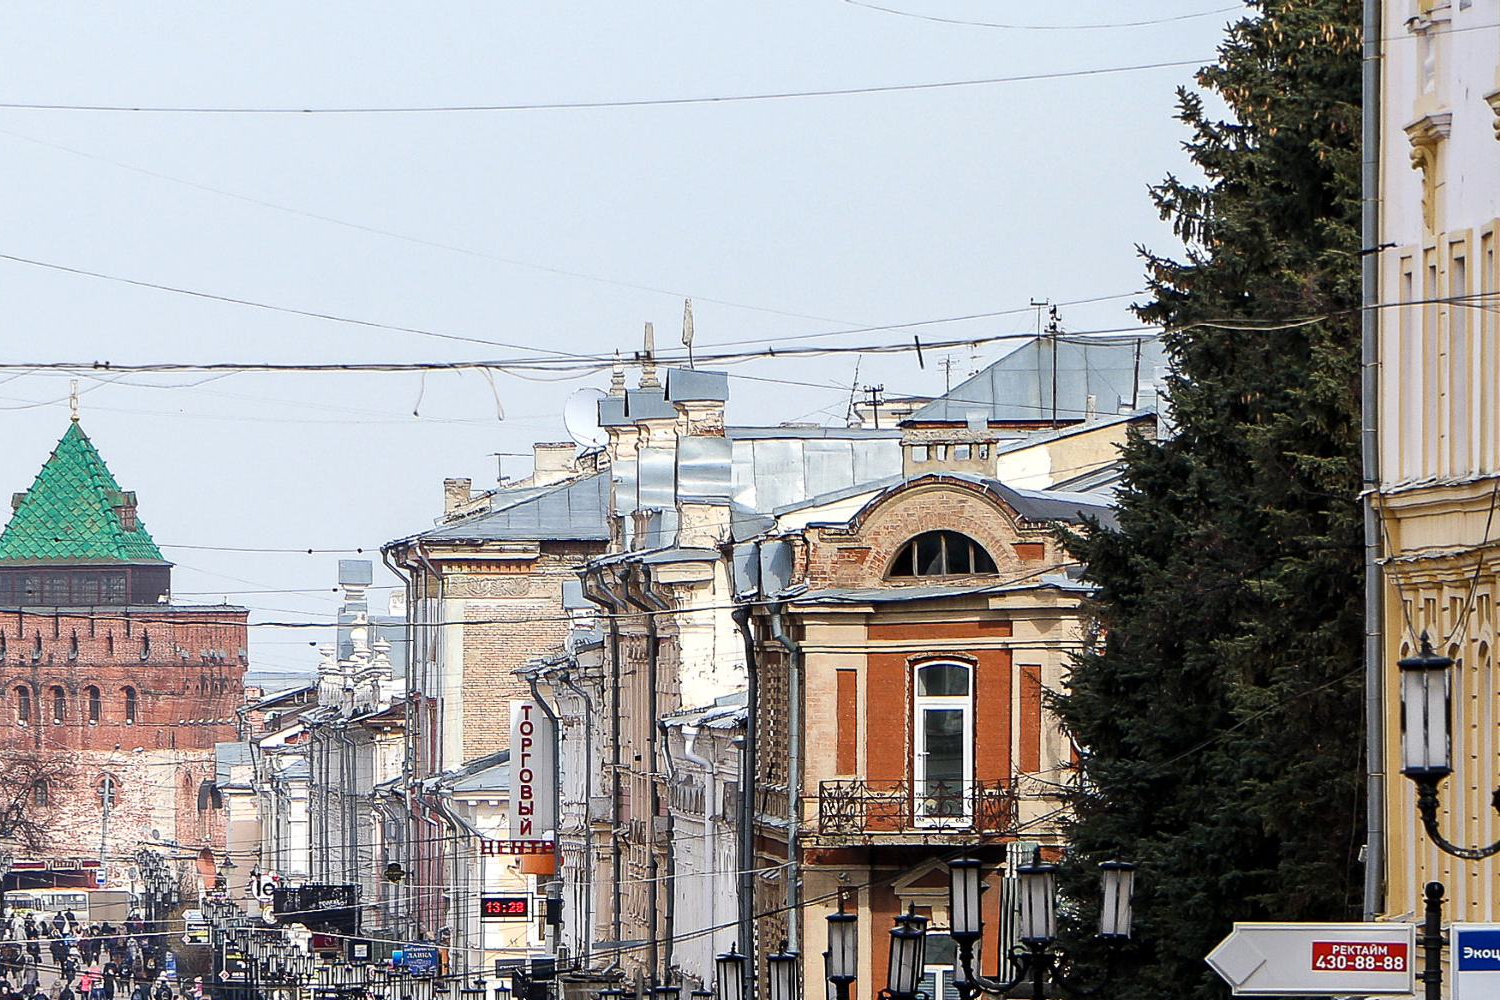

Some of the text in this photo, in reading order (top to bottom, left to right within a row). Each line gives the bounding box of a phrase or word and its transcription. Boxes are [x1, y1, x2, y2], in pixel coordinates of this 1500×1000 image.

[518, 705, 534, 836] ТОРГОВЫЙ
[481, 840, 555, 857] ЦЕНТР
[485, 901, 526, 913] 13:28
[1332, 943, 1388, 956] РЕКТАЙМ
[1315, 955, 1405, 971] 430-88-88
